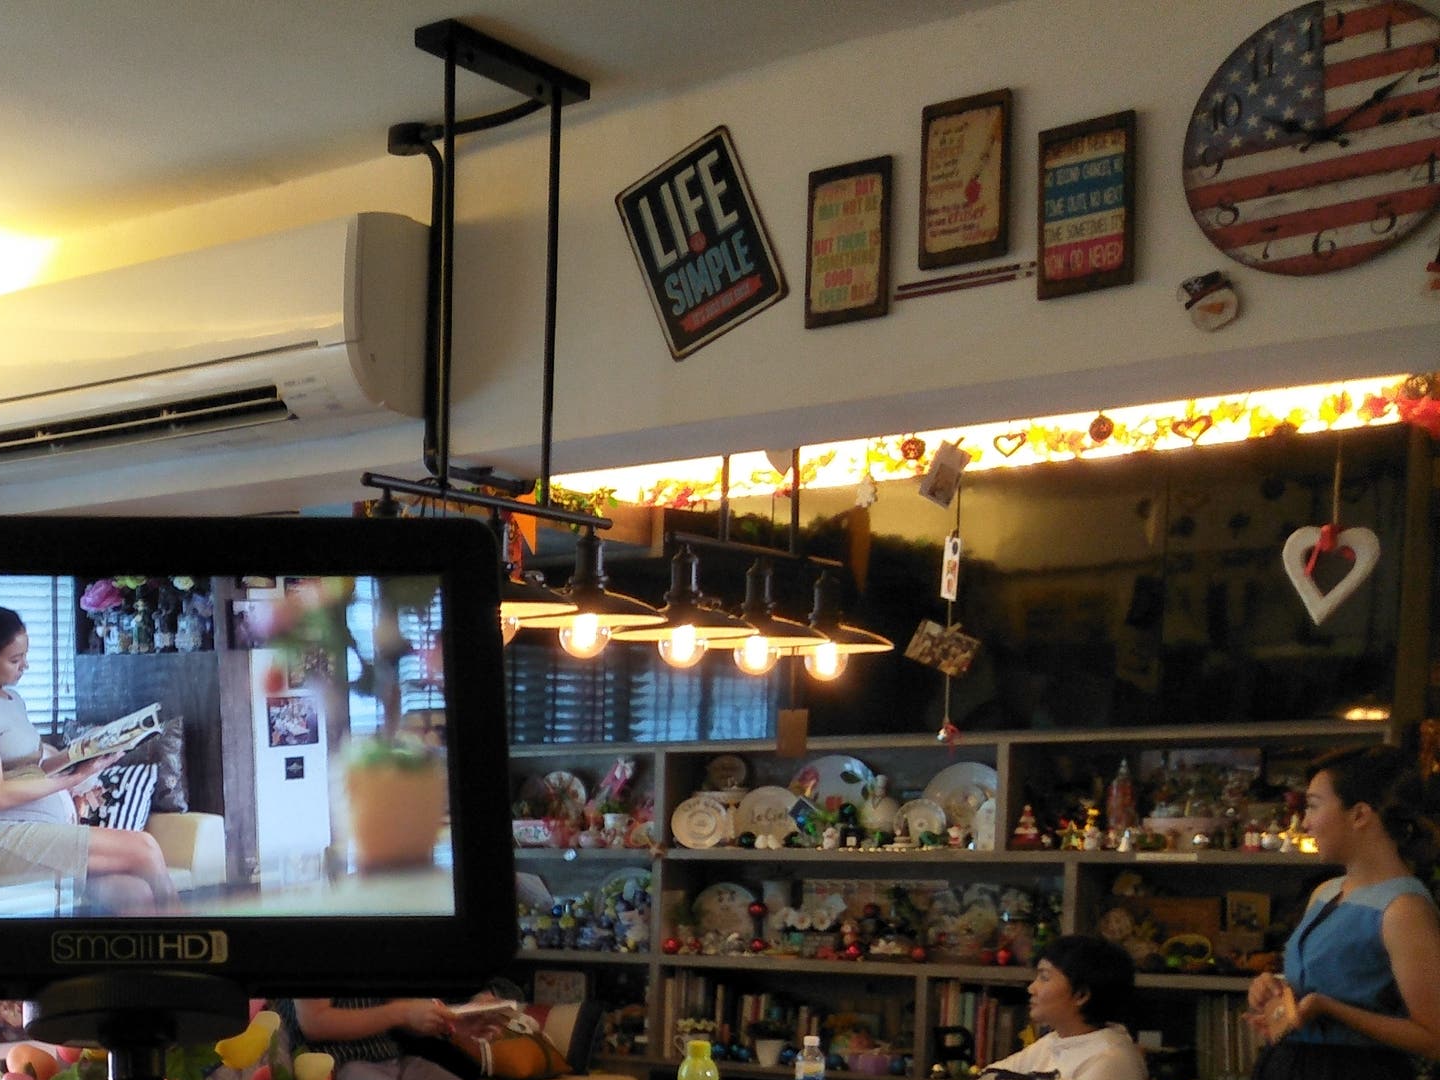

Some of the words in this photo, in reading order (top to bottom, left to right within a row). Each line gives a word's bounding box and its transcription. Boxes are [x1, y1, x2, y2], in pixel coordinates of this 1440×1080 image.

[638, 149, 740, 272] LIFE
[1215, 198, 1240, 228] 8
[664, 229, 755, 316] SIMPLE
